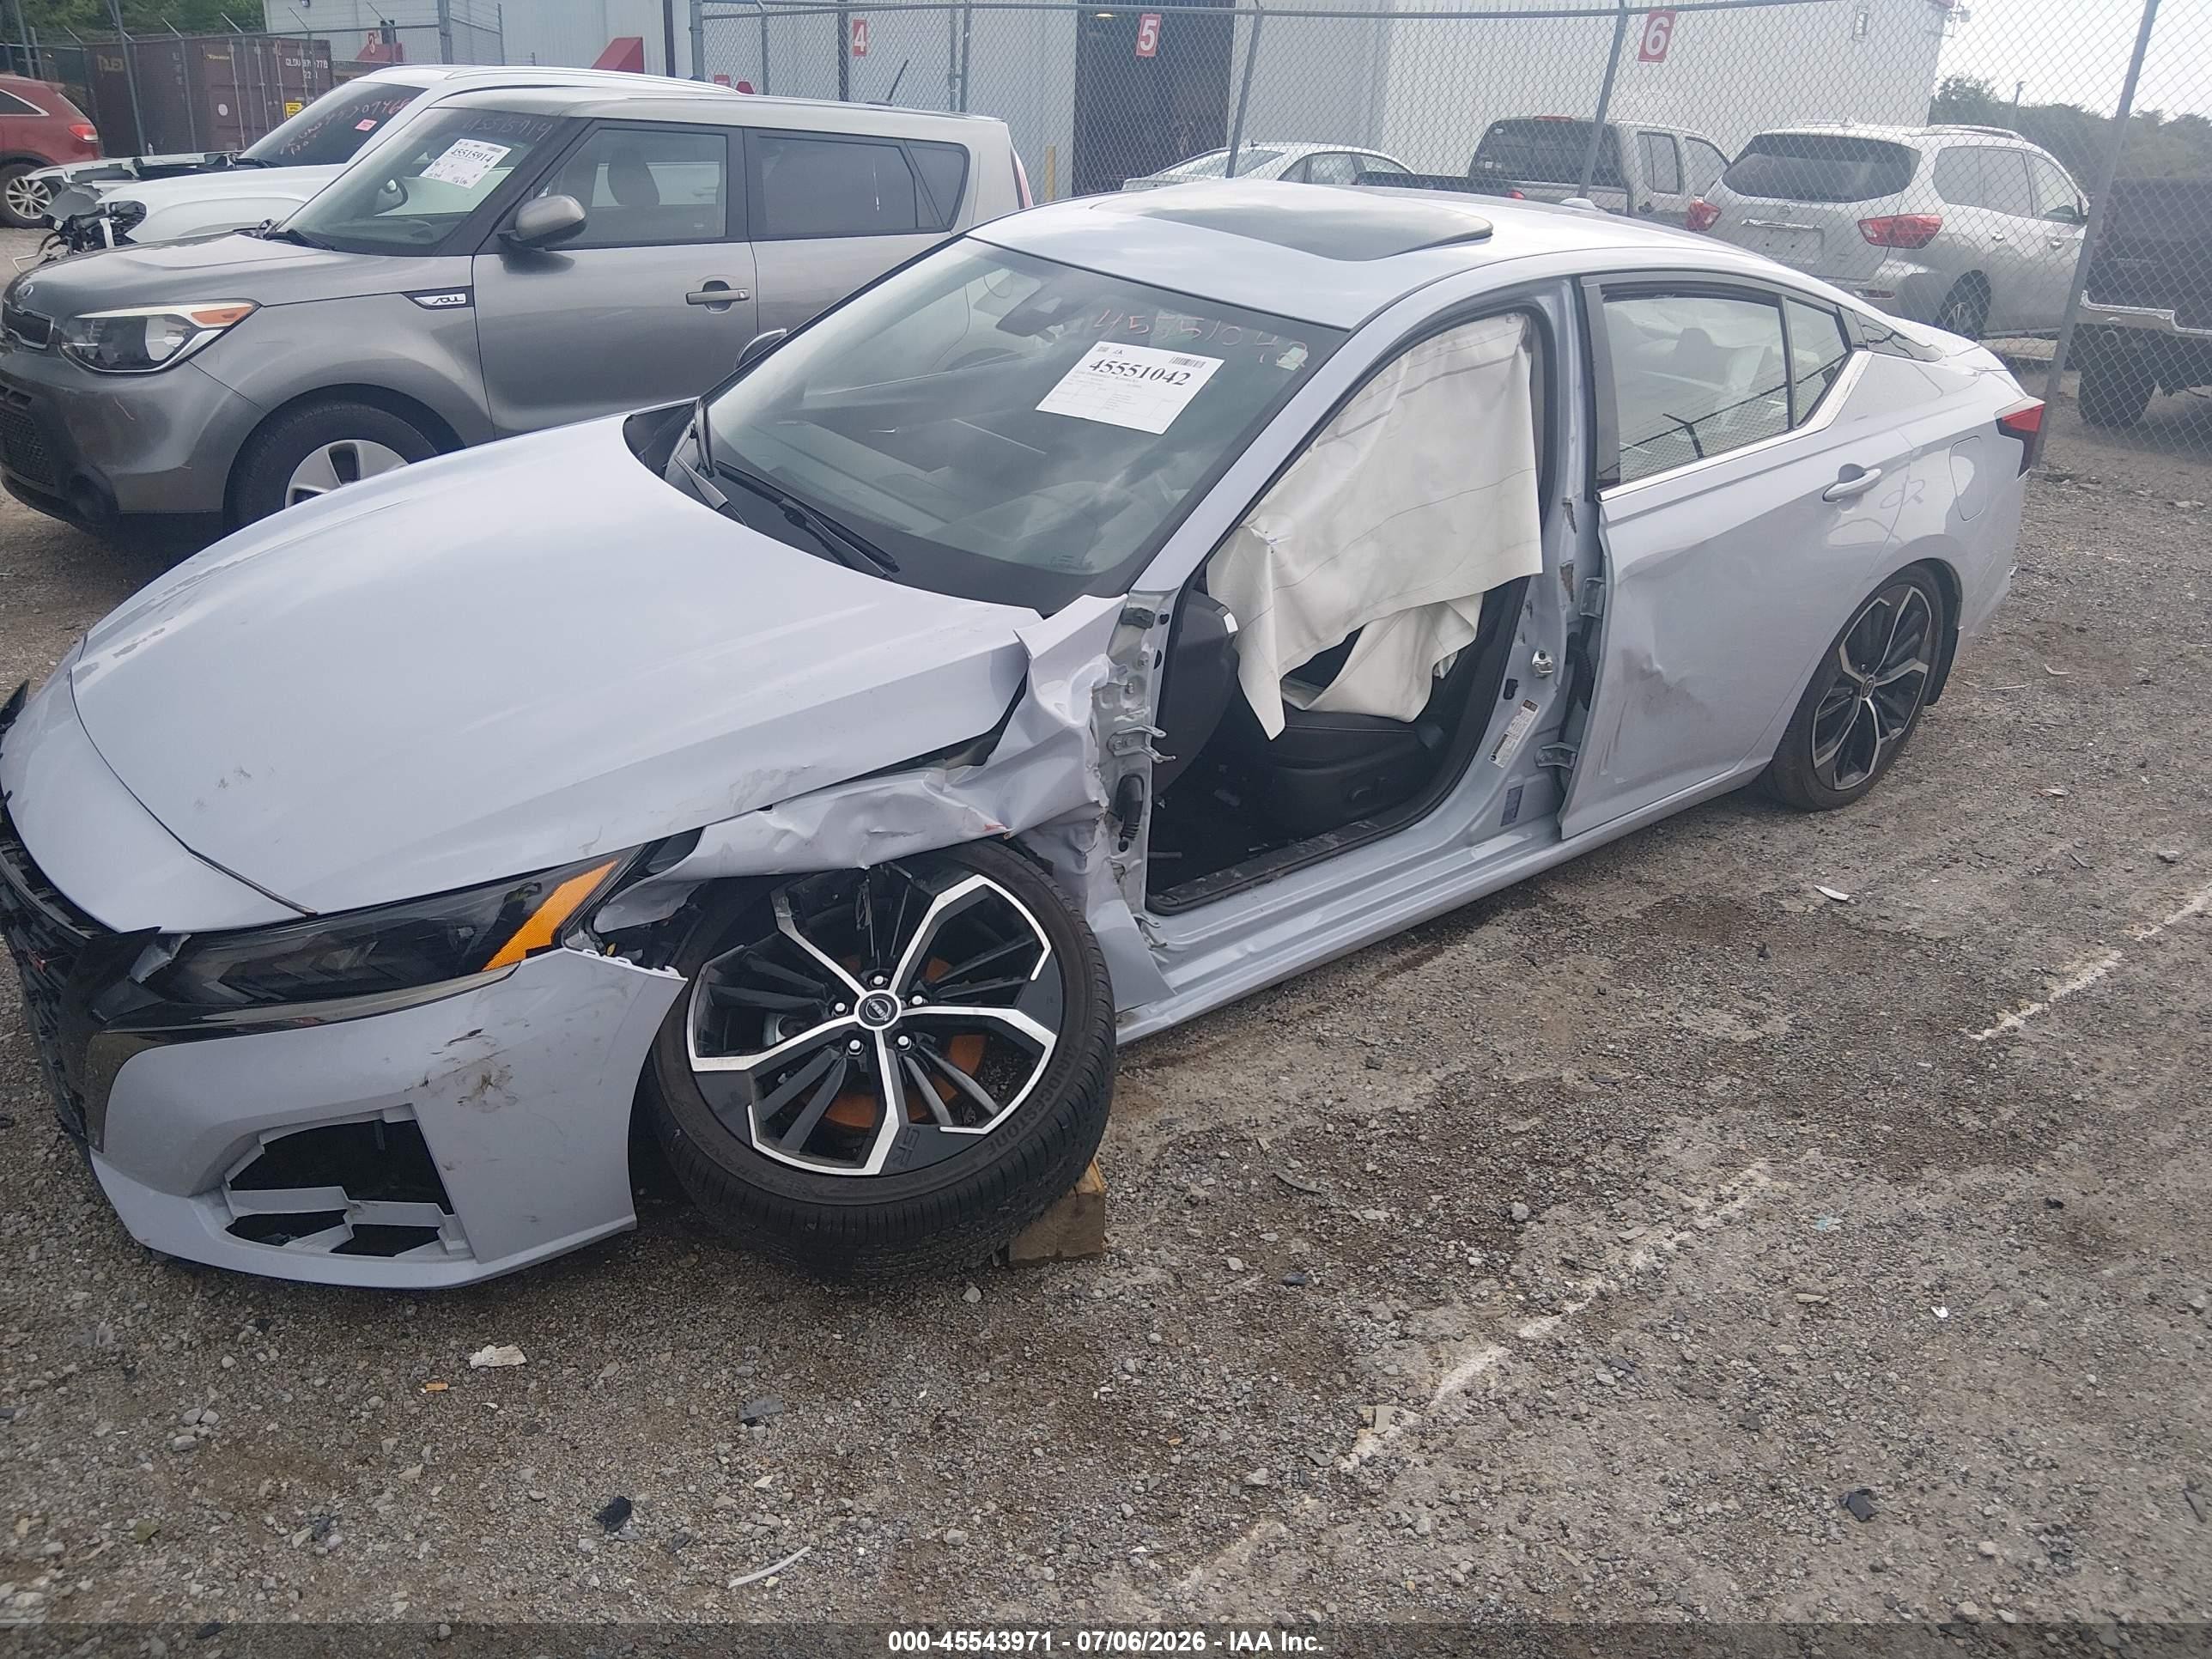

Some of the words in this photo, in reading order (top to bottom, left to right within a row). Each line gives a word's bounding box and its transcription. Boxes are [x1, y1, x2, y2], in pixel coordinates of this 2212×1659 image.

[369, 34, 375, 53] 3
[854, 24, 866, 52] 4
[1139, 19, 1158, 51] 5
[1645, 16, 1670, 56] 6
[1089, 358, 1192, 386] 45551042
